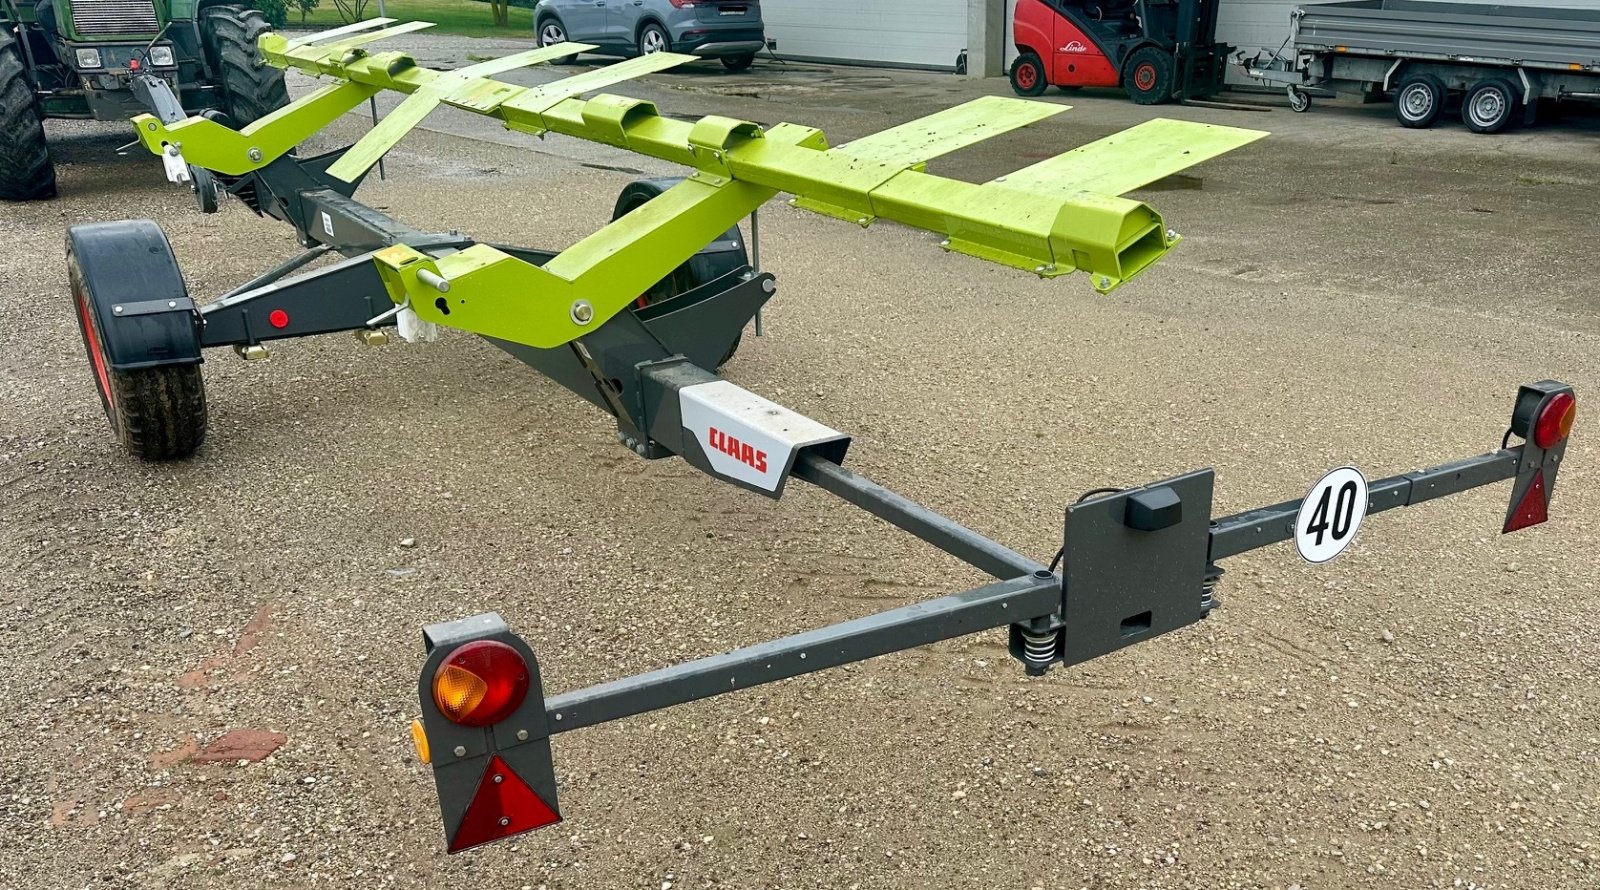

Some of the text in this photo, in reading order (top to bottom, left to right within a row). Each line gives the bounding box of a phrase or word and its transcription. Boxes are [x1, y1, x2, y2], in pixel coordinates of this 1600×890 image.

[1059, 40, 1087, 52] Linde
[709, 427, 767, 474] CLAAS
[1306, 481, 1358, 546] 40
